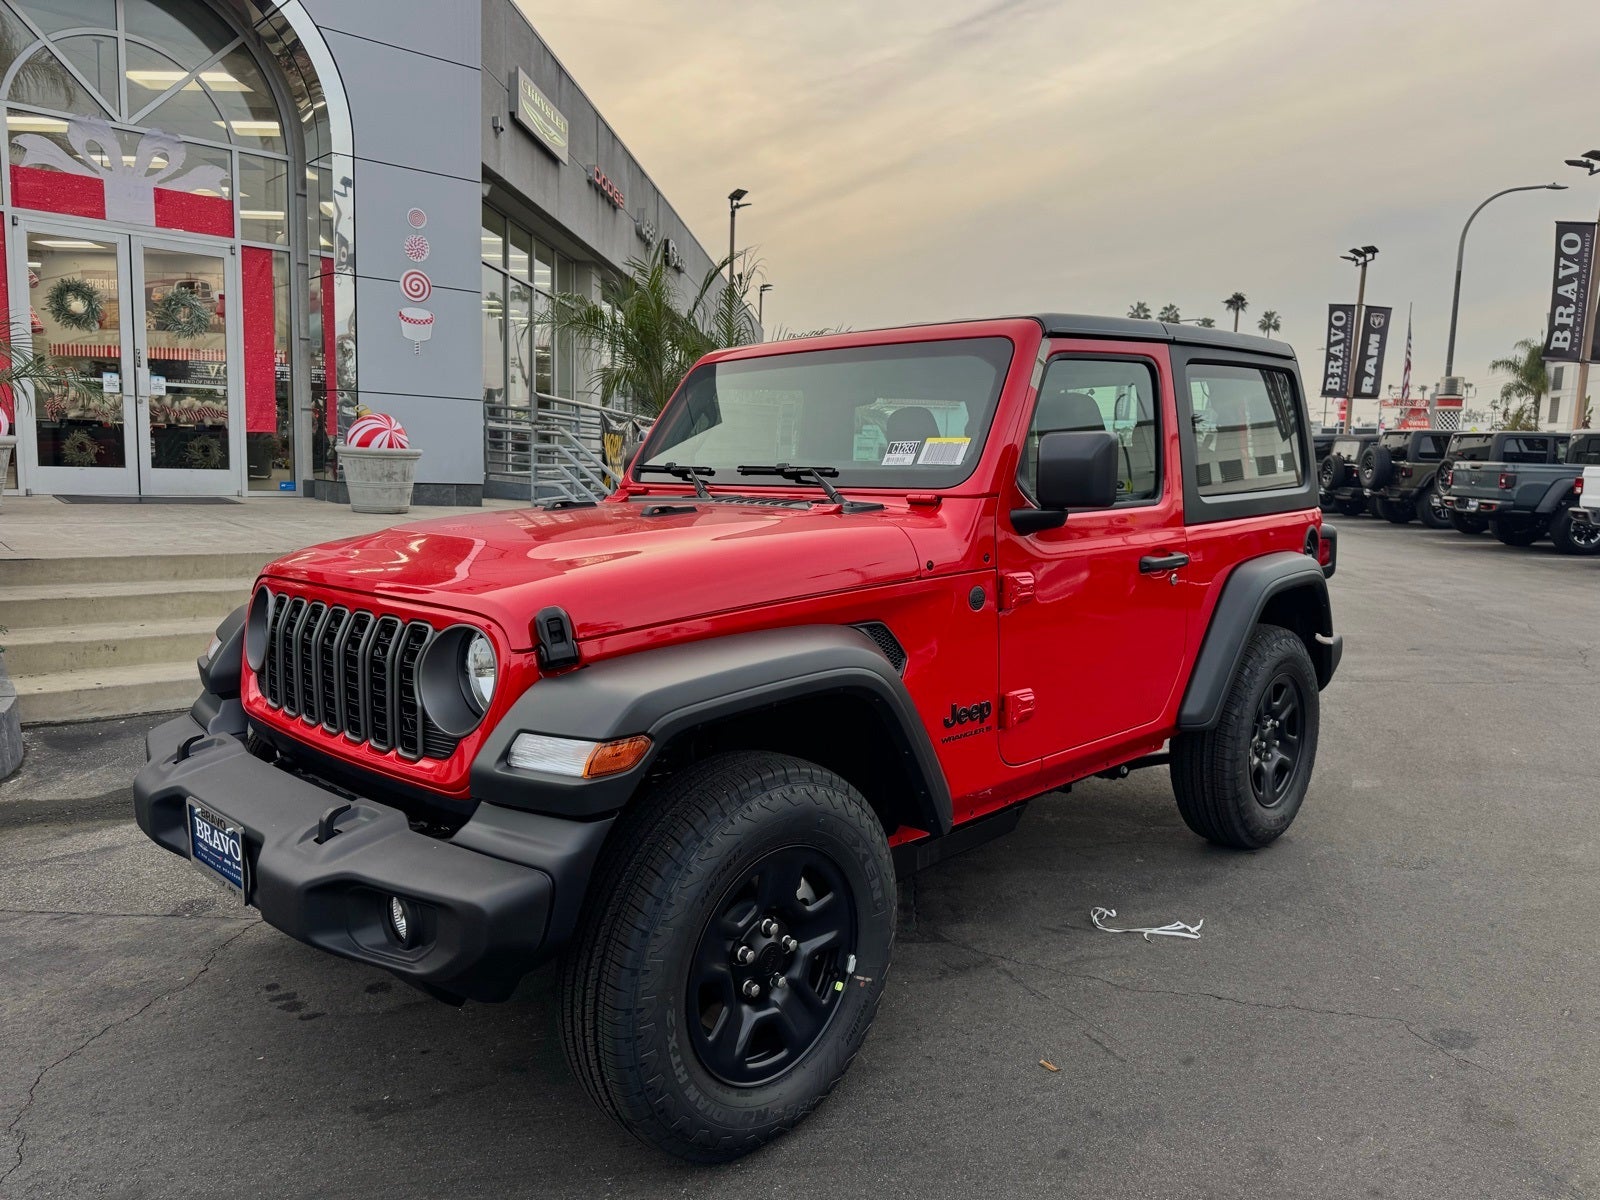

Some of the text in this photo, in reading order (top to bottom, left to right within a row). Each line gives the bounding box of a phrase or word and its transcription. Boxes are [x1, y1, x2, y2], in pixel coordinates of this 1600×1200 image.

[594, 165, 625, 208] DODGE
[1550, 232, 1582, 351] BRAVO
[1326, 311, 1347, 391] BRAVO
[1361, 333, 1381, 394] RAM
[941, 727, 985, 745] WRANGLER
[943, 700, 992, 729] Jeep
[194, 816, 241, 861] BRAVO
[200, 809, 227, 831] BRAVO
